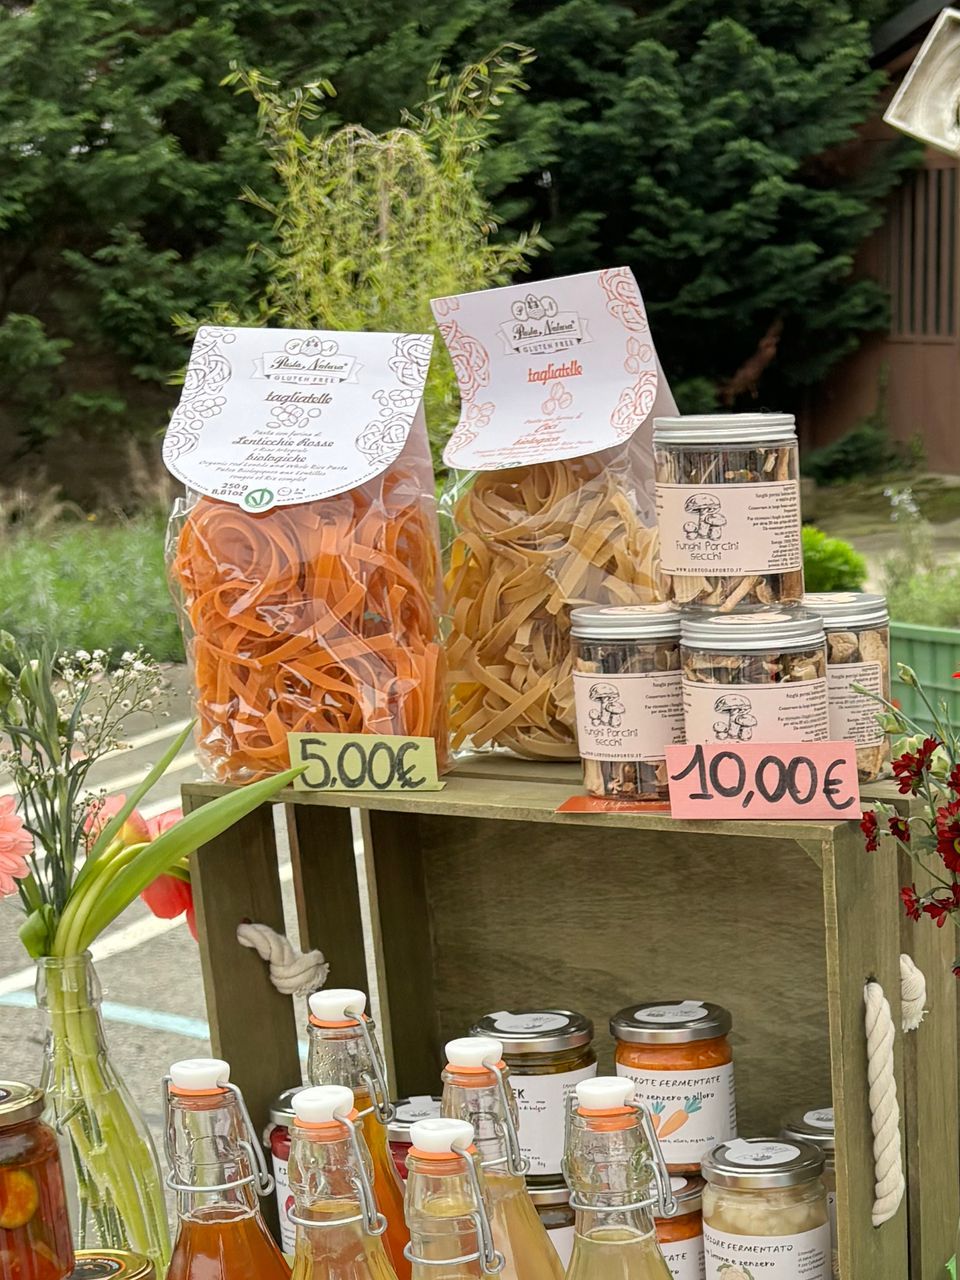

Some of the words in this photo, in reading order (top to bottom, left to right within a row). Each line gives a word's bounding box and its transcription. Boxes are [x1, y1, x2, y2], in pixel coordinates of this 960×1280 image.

[523, 341, 552, 353] GLUTEN
[528, 360, 583, 385] tagliatelle
[264, 391, 333, 405] tagliatelle
[297, 438, 334, 447] Rosse
[245, 453, 307, 463] biologiche
[705, 541, 739, 551] Porcini
[300, 738, 426, 789] 5,00€
[671, 745, 856, 810] 10,00€
[659, 1075, 721, 1087] FERMENTATE
[692, 1092, 715, 1101] alloro
[727, 1243, 793, 1253] FERMENTATO
